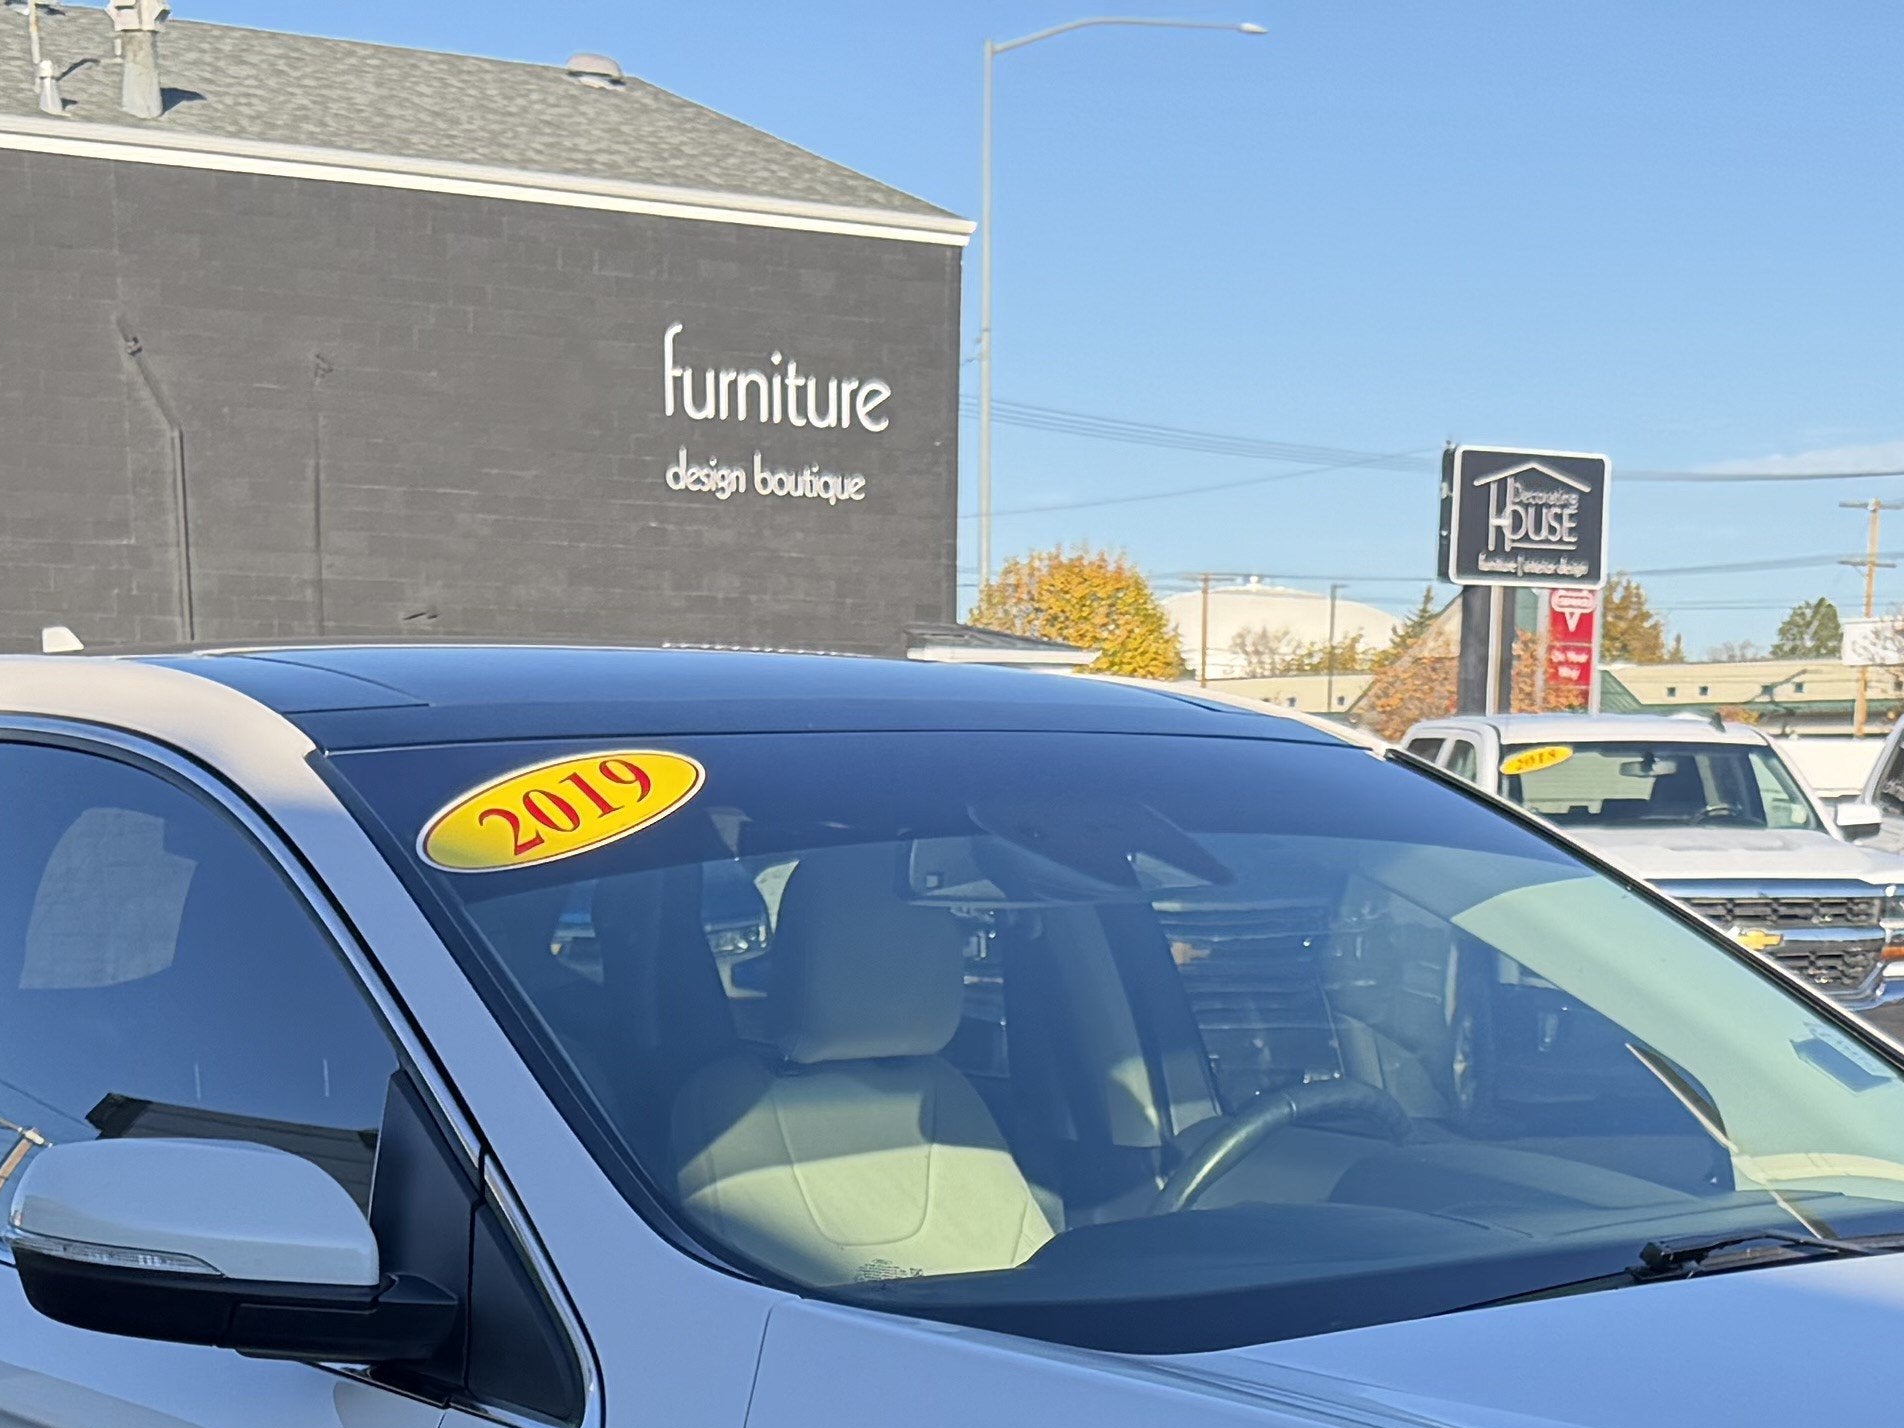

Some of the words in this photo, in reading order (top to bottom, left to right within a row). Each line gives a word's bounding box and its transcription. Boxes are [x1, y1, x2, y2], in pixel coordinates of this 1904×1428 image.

[664, 322, 891, 432] furniture
[665, 445, 746, 500] design
[753, 450, 866, 506] boutique
[479, 759, 652, 856] 2019
